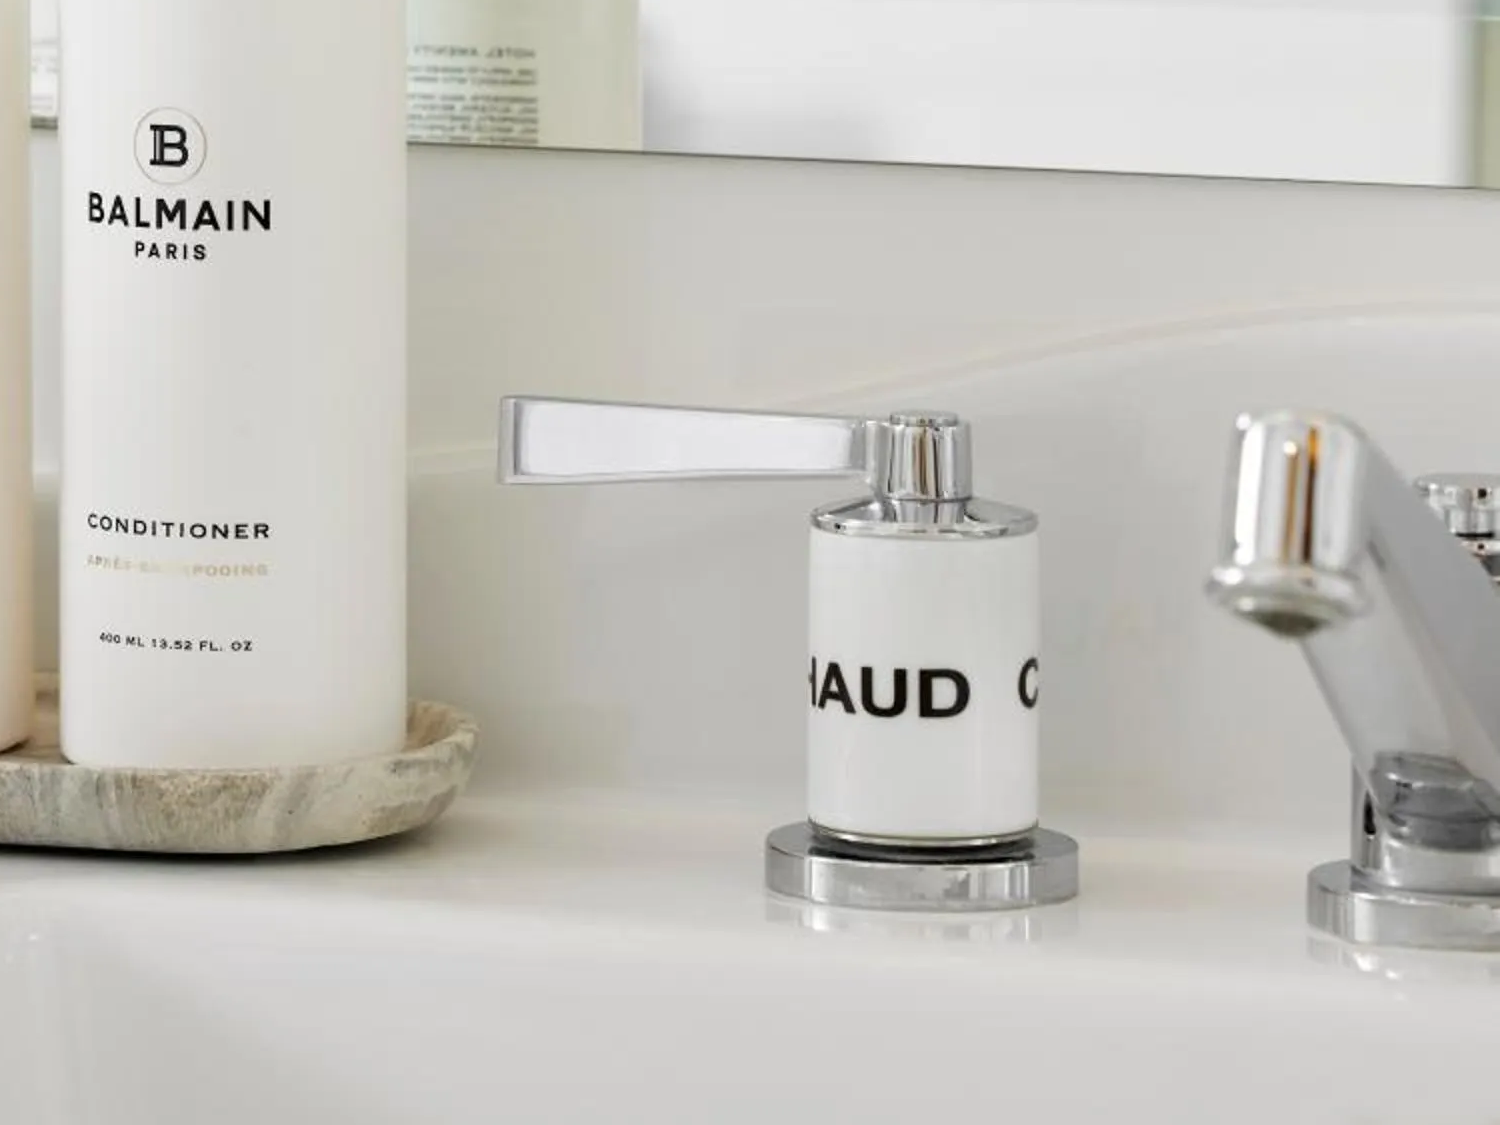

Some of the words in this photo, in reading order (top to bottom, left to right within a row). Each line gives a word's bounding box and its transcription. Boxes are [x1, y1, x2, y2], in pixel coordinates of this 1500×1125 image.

[149, 123, 190, 168] B
[88, 191, 271, 232] BALMAIN
[134, 240, 207, 261] PARIS
[87, 512, 270, 539] CONDITIONER
[100, 631, 122, 645] 400
[126, 635, 145, 648] ML
[151, 638, 193, 652] 13.52
[199, 639, 223, 652] FL.
[230, 640, 253, 652] OZ
